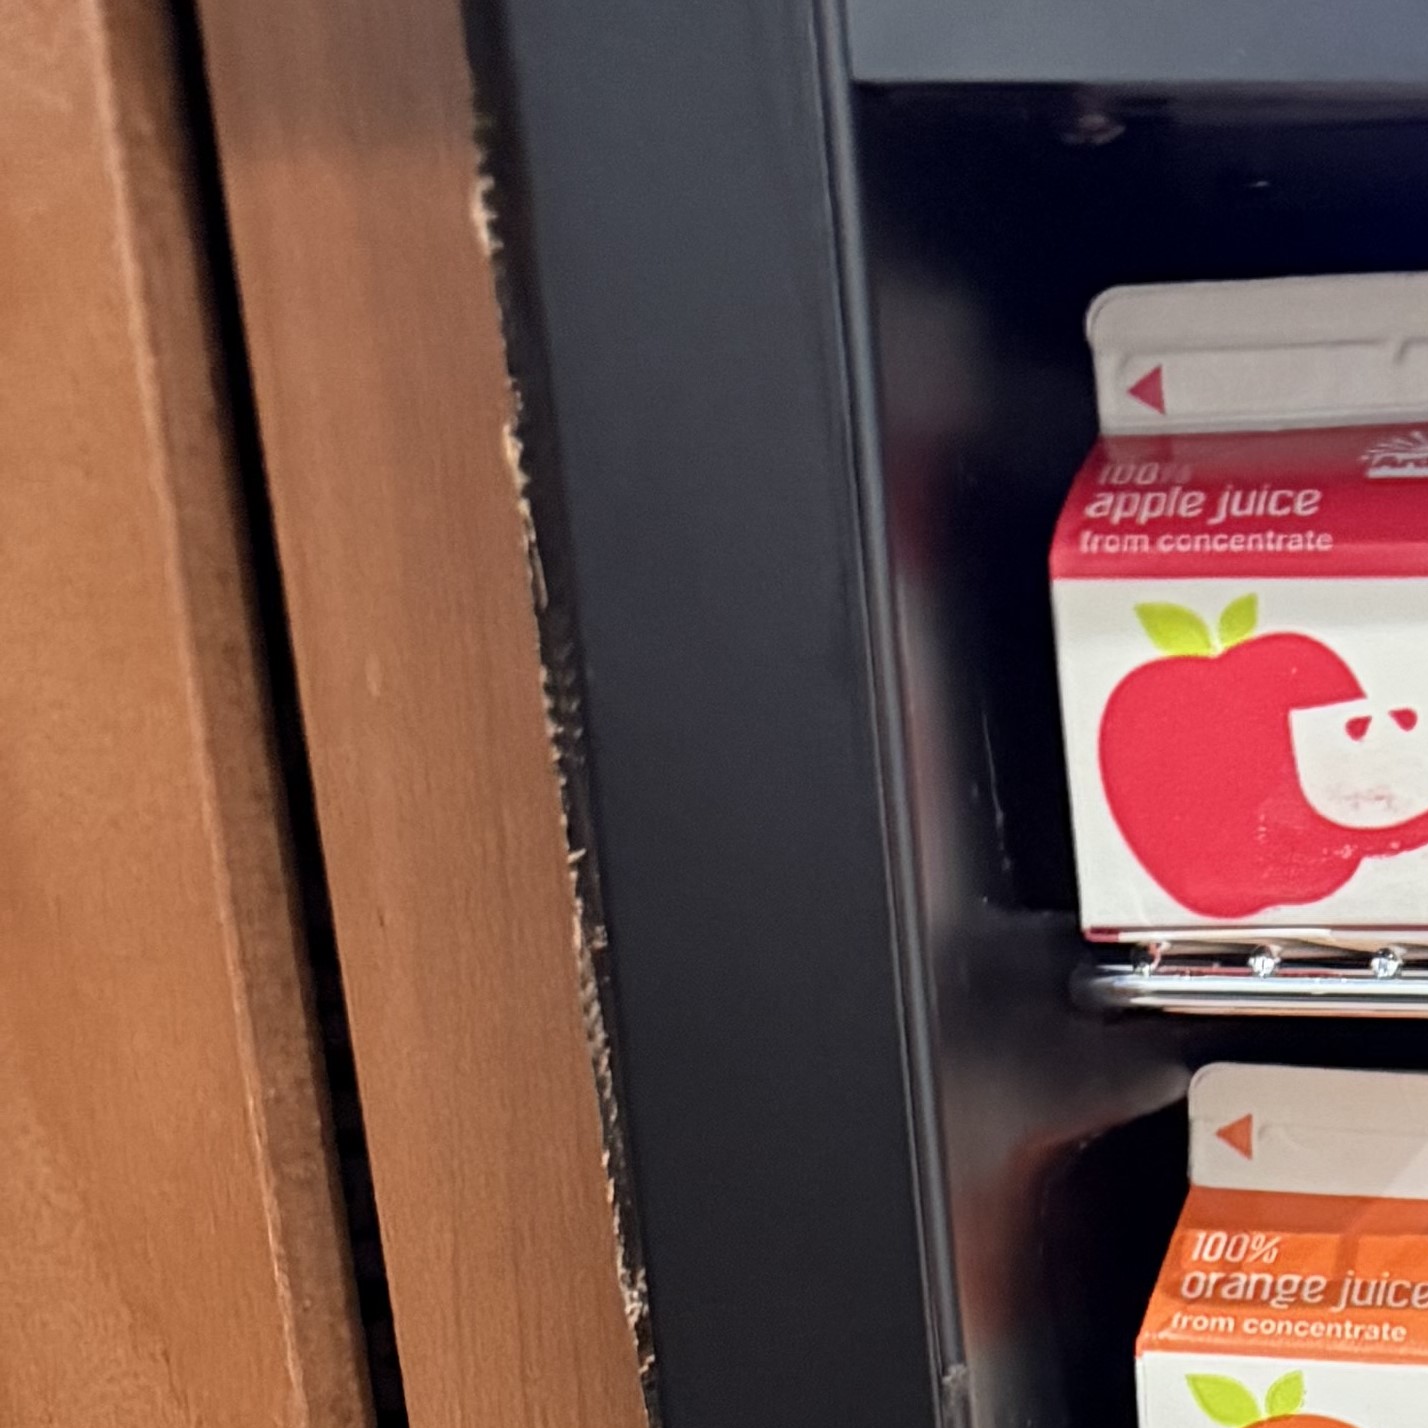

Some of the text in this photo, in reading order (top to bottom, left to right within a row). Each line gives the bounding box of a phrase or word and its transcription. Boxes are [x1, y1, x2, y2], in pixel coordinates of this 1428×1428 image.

[1083, 484, 1322, 526] apple juice
[1080, 530, 1334, 554] from concentrate
[1190, 1231, 1282, 1264] 100%
[1180, 1270, 1327, 1309] orange
[1171, 1311, 1407, 1342] from concentrate
